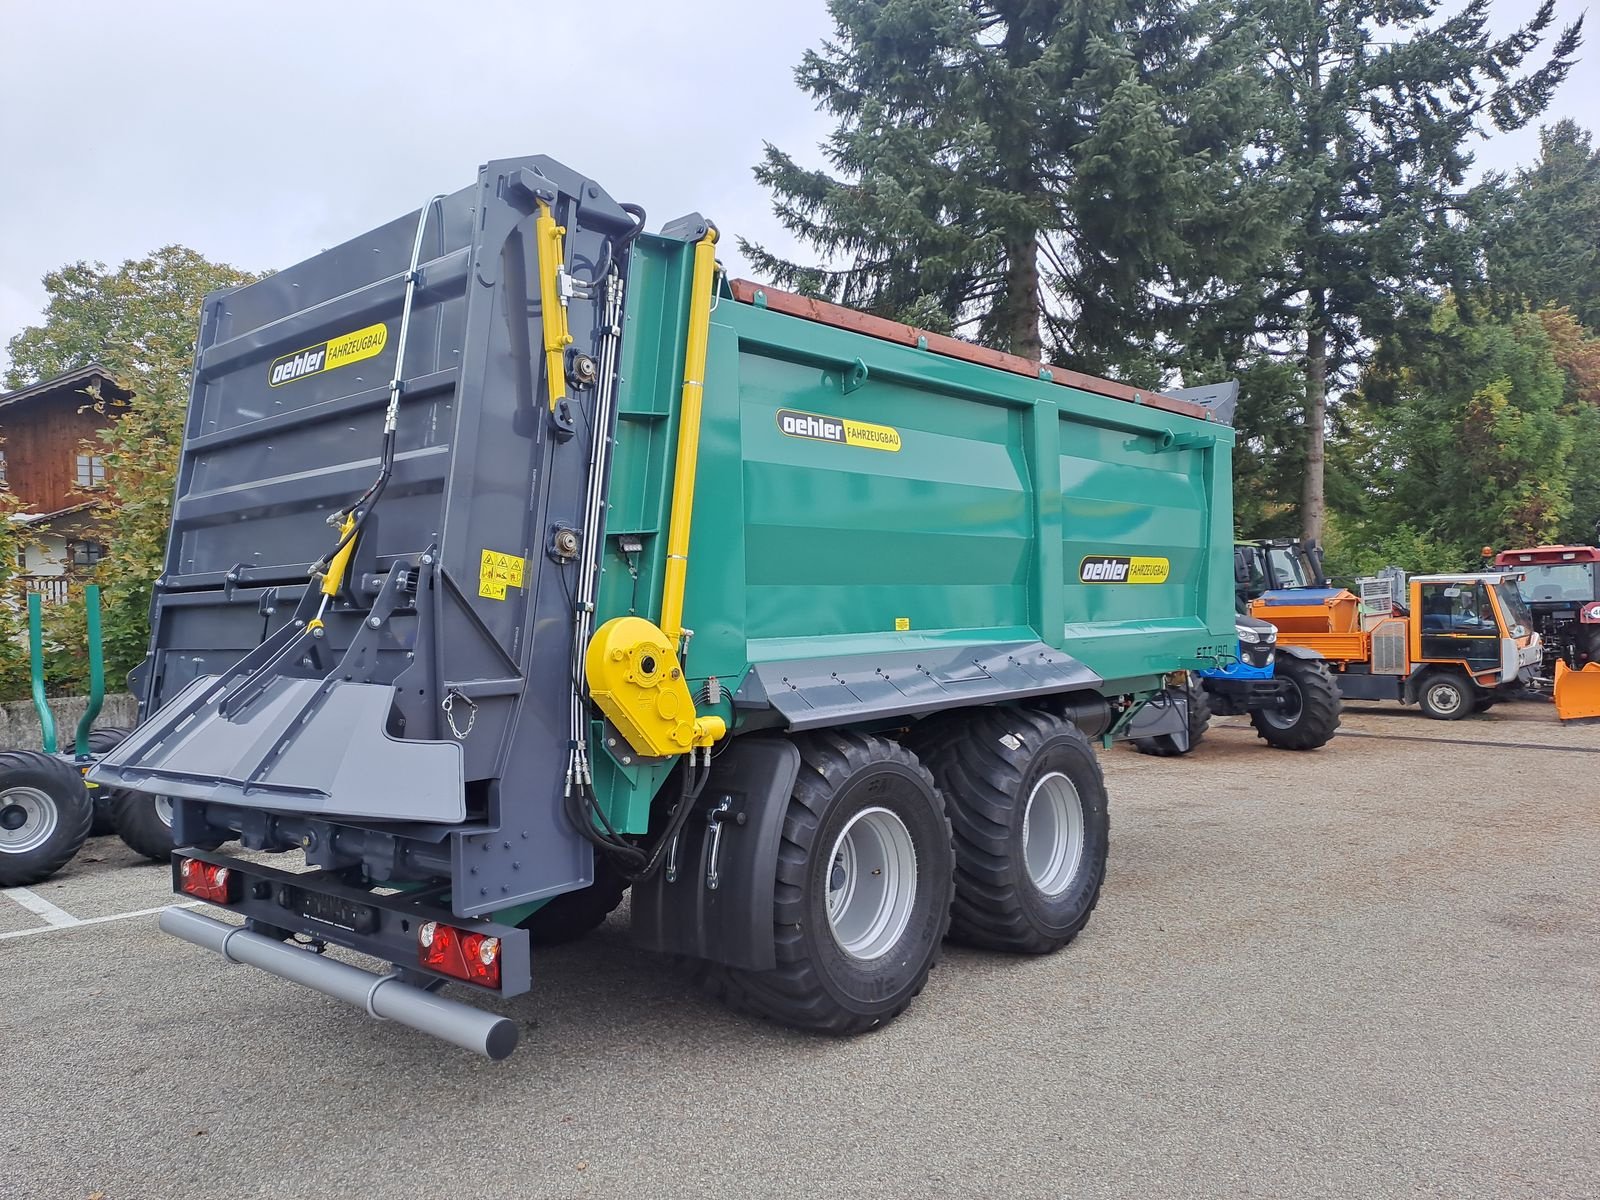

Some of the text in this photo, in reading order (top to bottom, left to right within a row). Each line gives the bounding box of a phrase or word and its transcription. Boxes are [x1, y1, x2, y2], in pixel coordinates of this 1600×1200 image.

[271, 330, 385, 384] oehler FAHRZEUGBAU
[783, 416, 899, 445] oehler FAHRZEUGBAU
[1082, 559, 1168, 580] oehler FAHRZEUGBAU
